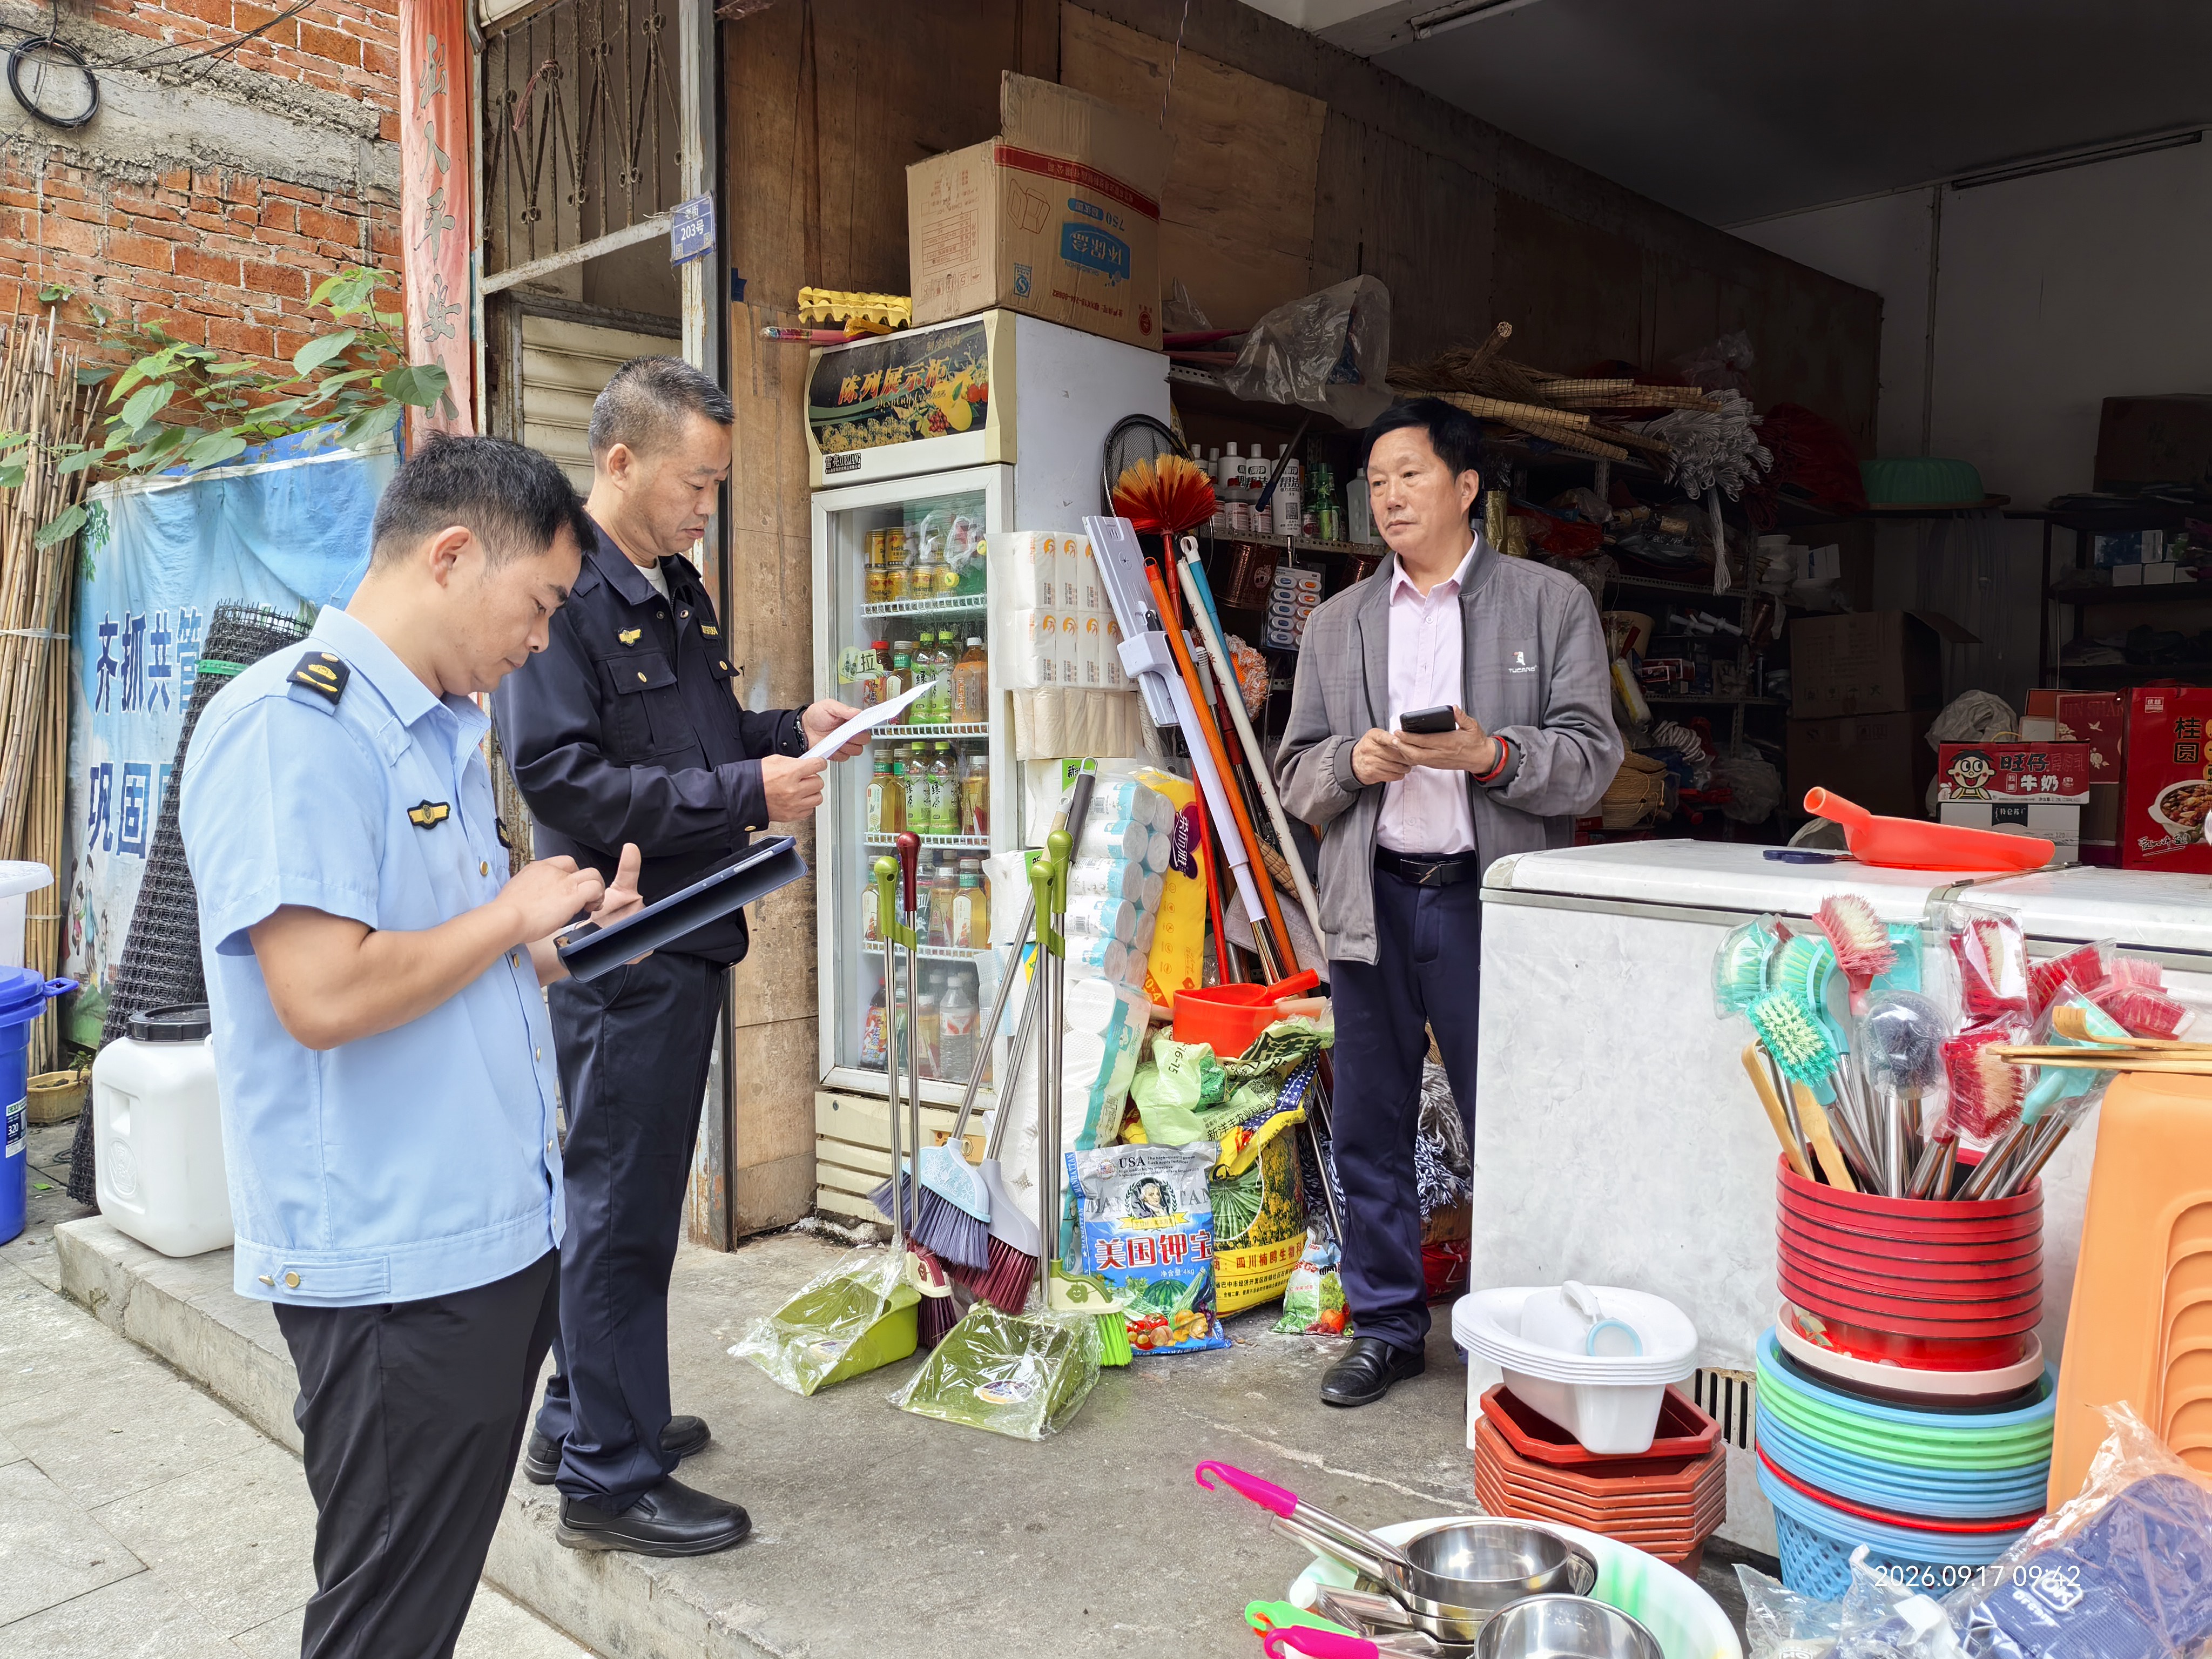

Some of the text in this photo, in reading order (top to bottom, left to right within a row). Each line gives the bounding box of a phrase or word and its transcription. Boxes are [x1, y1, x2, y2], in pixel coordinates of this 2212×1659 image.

[681, 219, 704, 241] 203号
[1106, 212, 1125, 231] 750
[838, 356, 949, 405] 陈列展示柜
[96, 605, 202, 717] 齐抓共管
[861, 652, 875, 672] 拉
[2175, 717, 2202, 763] 桂圆
[2000, 753, 2050, 772] 旺仔
[2021, 774, 2059, 792] 牛奶
[88, 762, 172, 858] 巩固
[1119, 1156, 1146, 1168] USA
[1095, 1229, 1212, 1271] 美国钾宝
